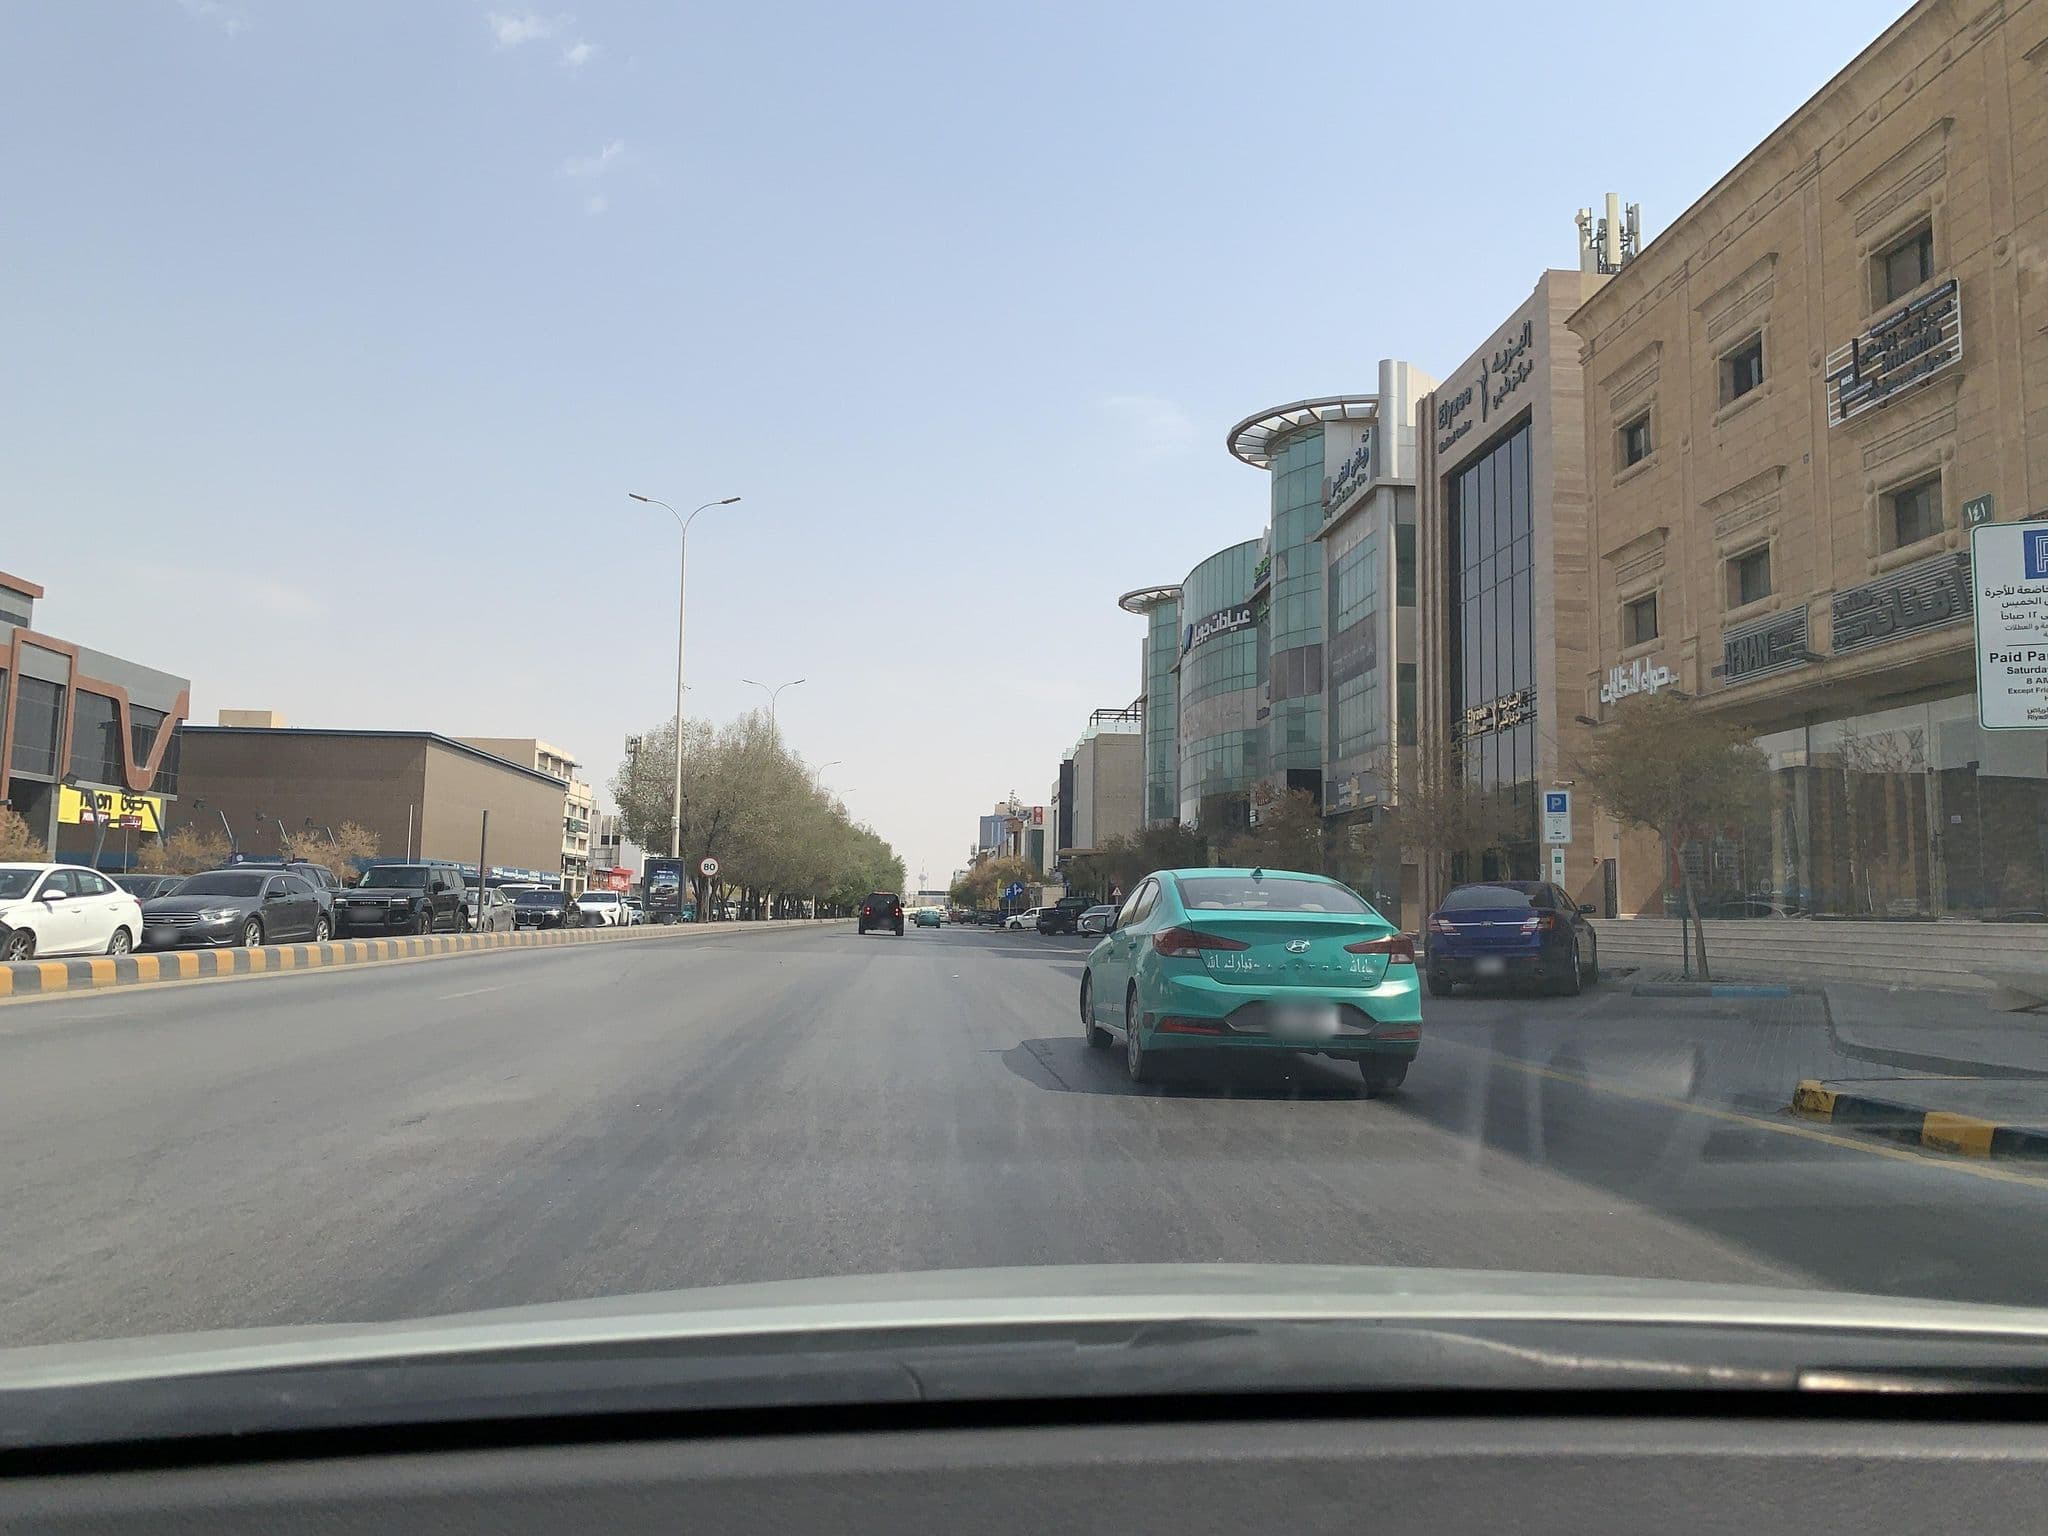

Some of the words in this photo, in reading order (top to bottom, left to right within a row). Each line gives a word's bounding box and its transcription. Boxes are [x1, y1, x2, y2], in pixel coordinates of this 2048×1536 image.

[1967, 502, 1986, 523] ١٤١
[1985, 584, 2015, 599] للأجرة
[2002, 596, 2041, 608] الخميس
[1210, 609, 1251, 633] عيادات
[1989, 651, 2022, 663] Paid
[2027, 650, 2048, 661] Pa
[2026, 677, 2033, 685] 8
[2007, 687, 2034, 695] Except
[703, 863, 716, 871] 80
